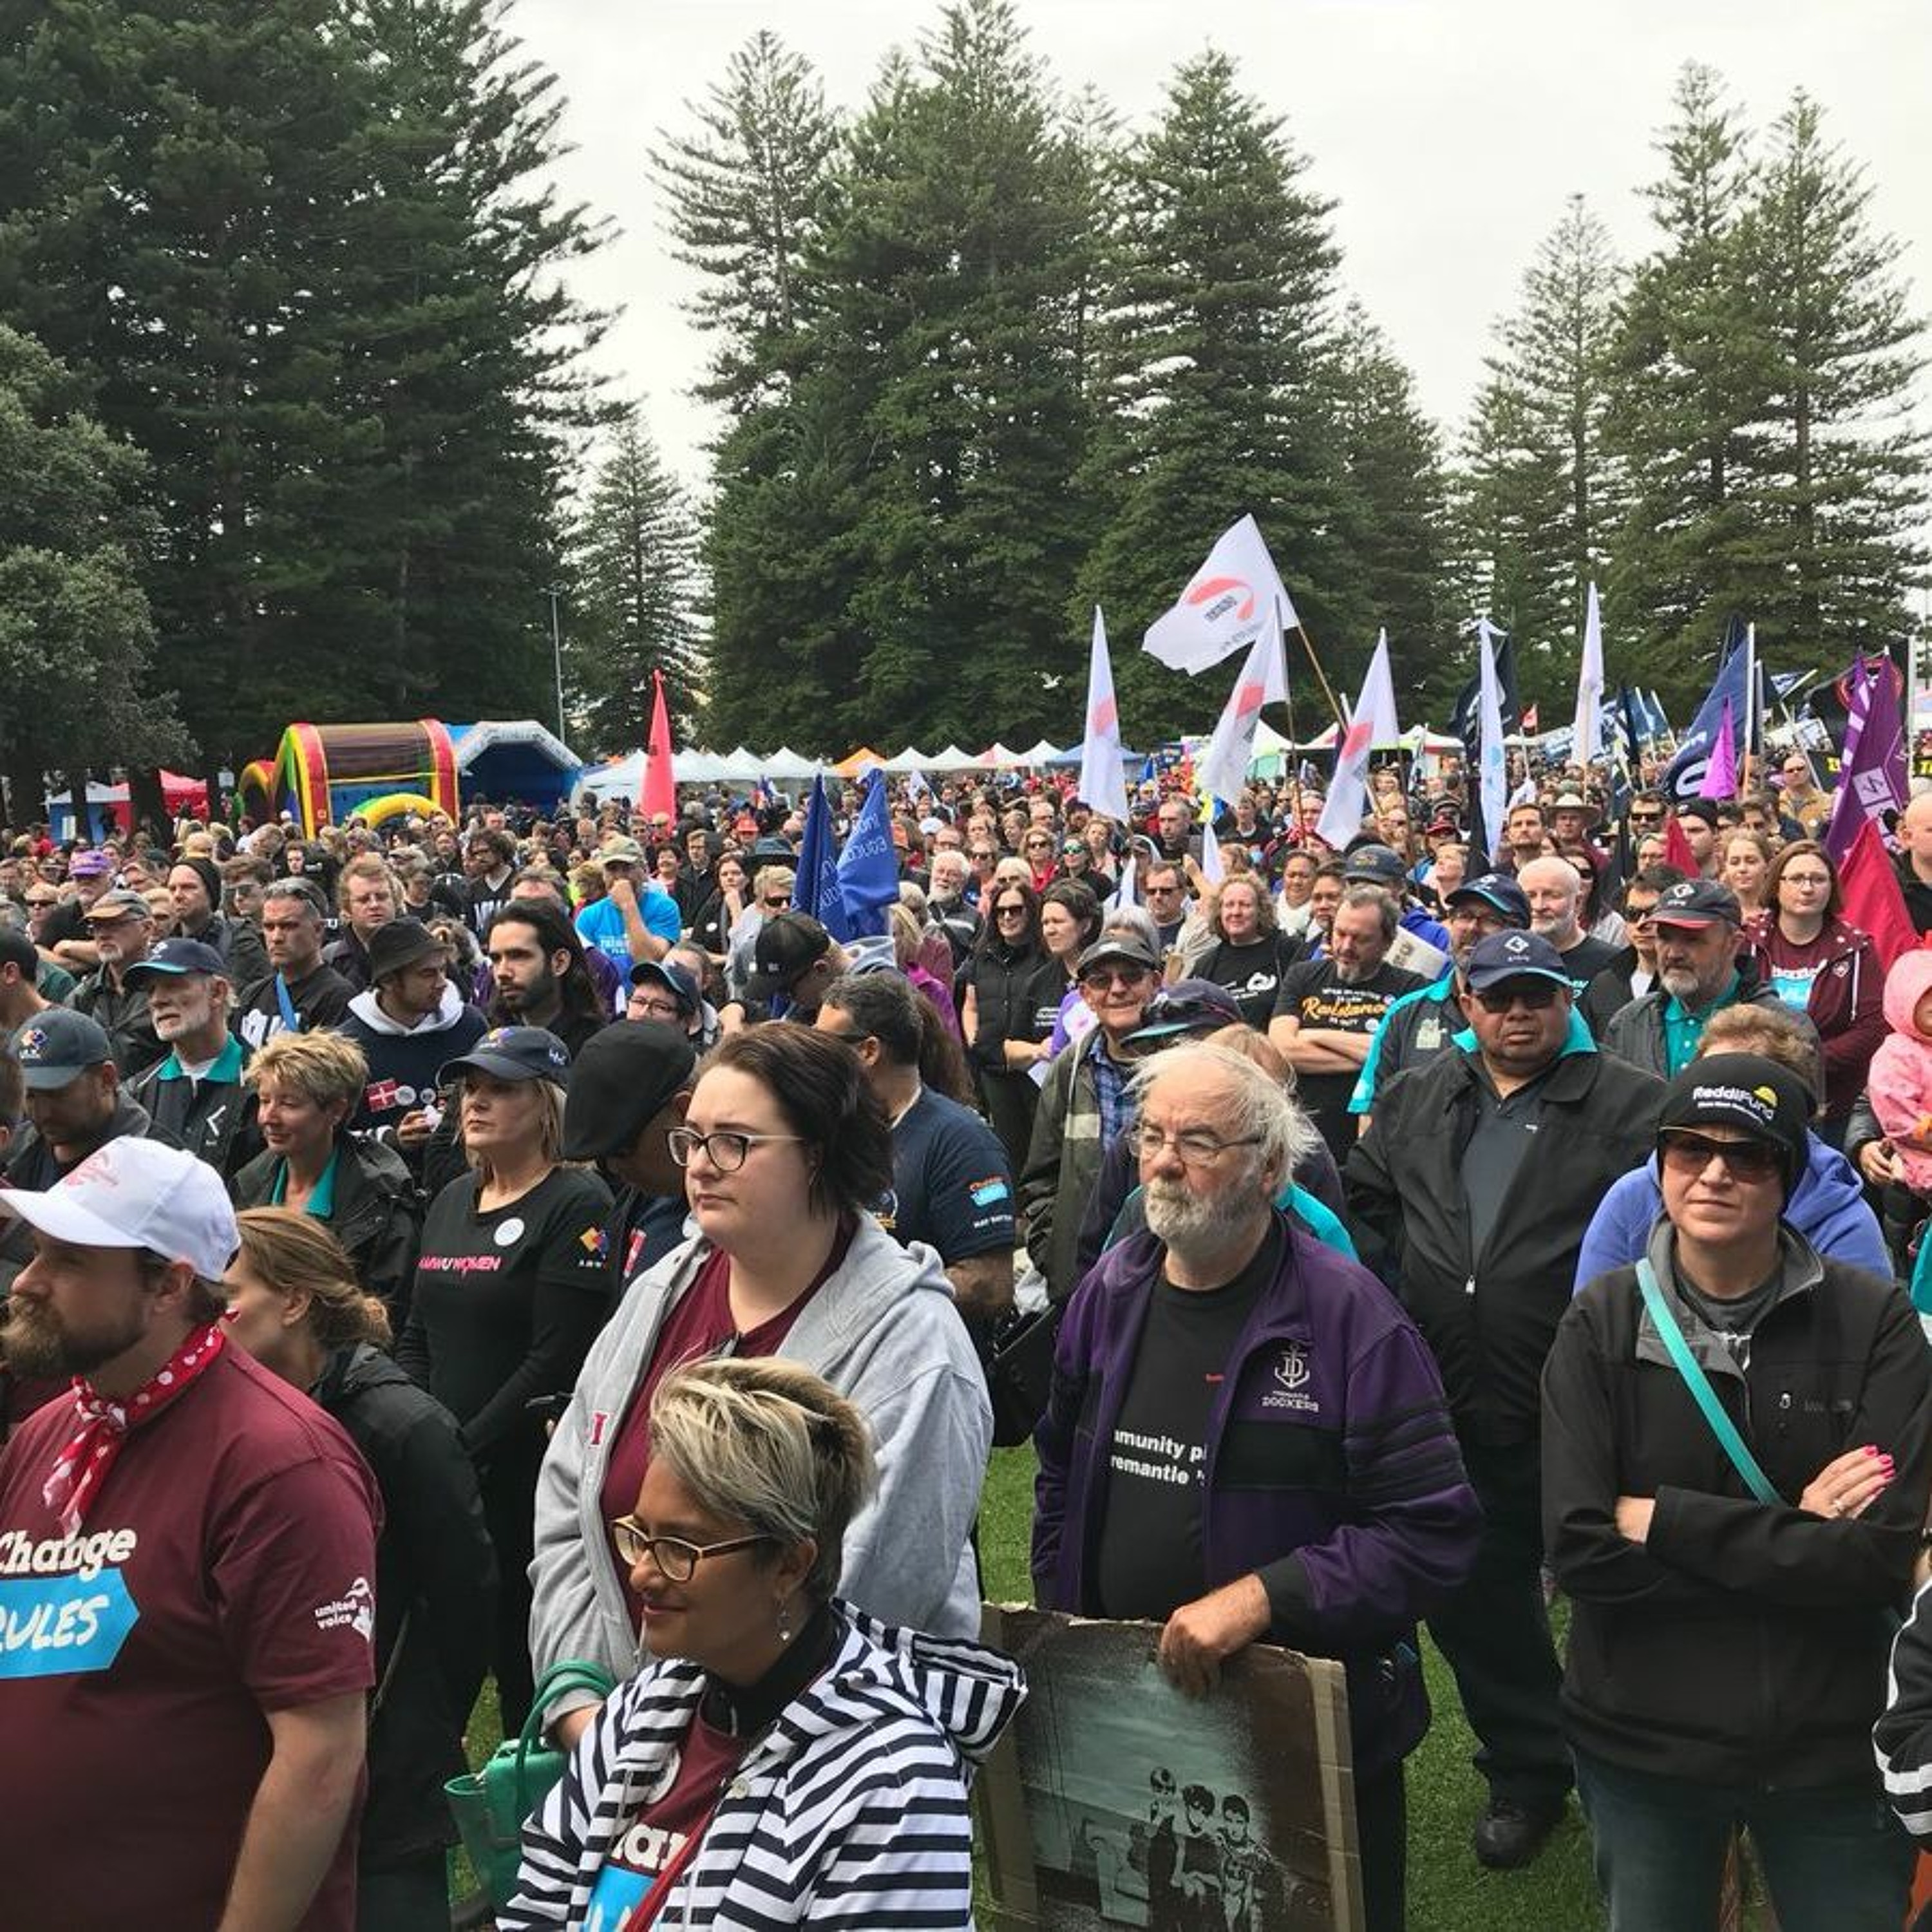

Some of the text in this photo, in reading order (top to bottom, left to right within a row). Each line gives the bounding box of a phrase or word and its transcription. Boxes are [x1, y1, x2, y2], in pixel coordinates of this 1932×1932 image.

[0, 1528, 137, 1582] Change
[0, 1594, 110, 1651] ULES
[315, 1597, 357, 1618] united
[317, 1614, 353, 1630] voice
